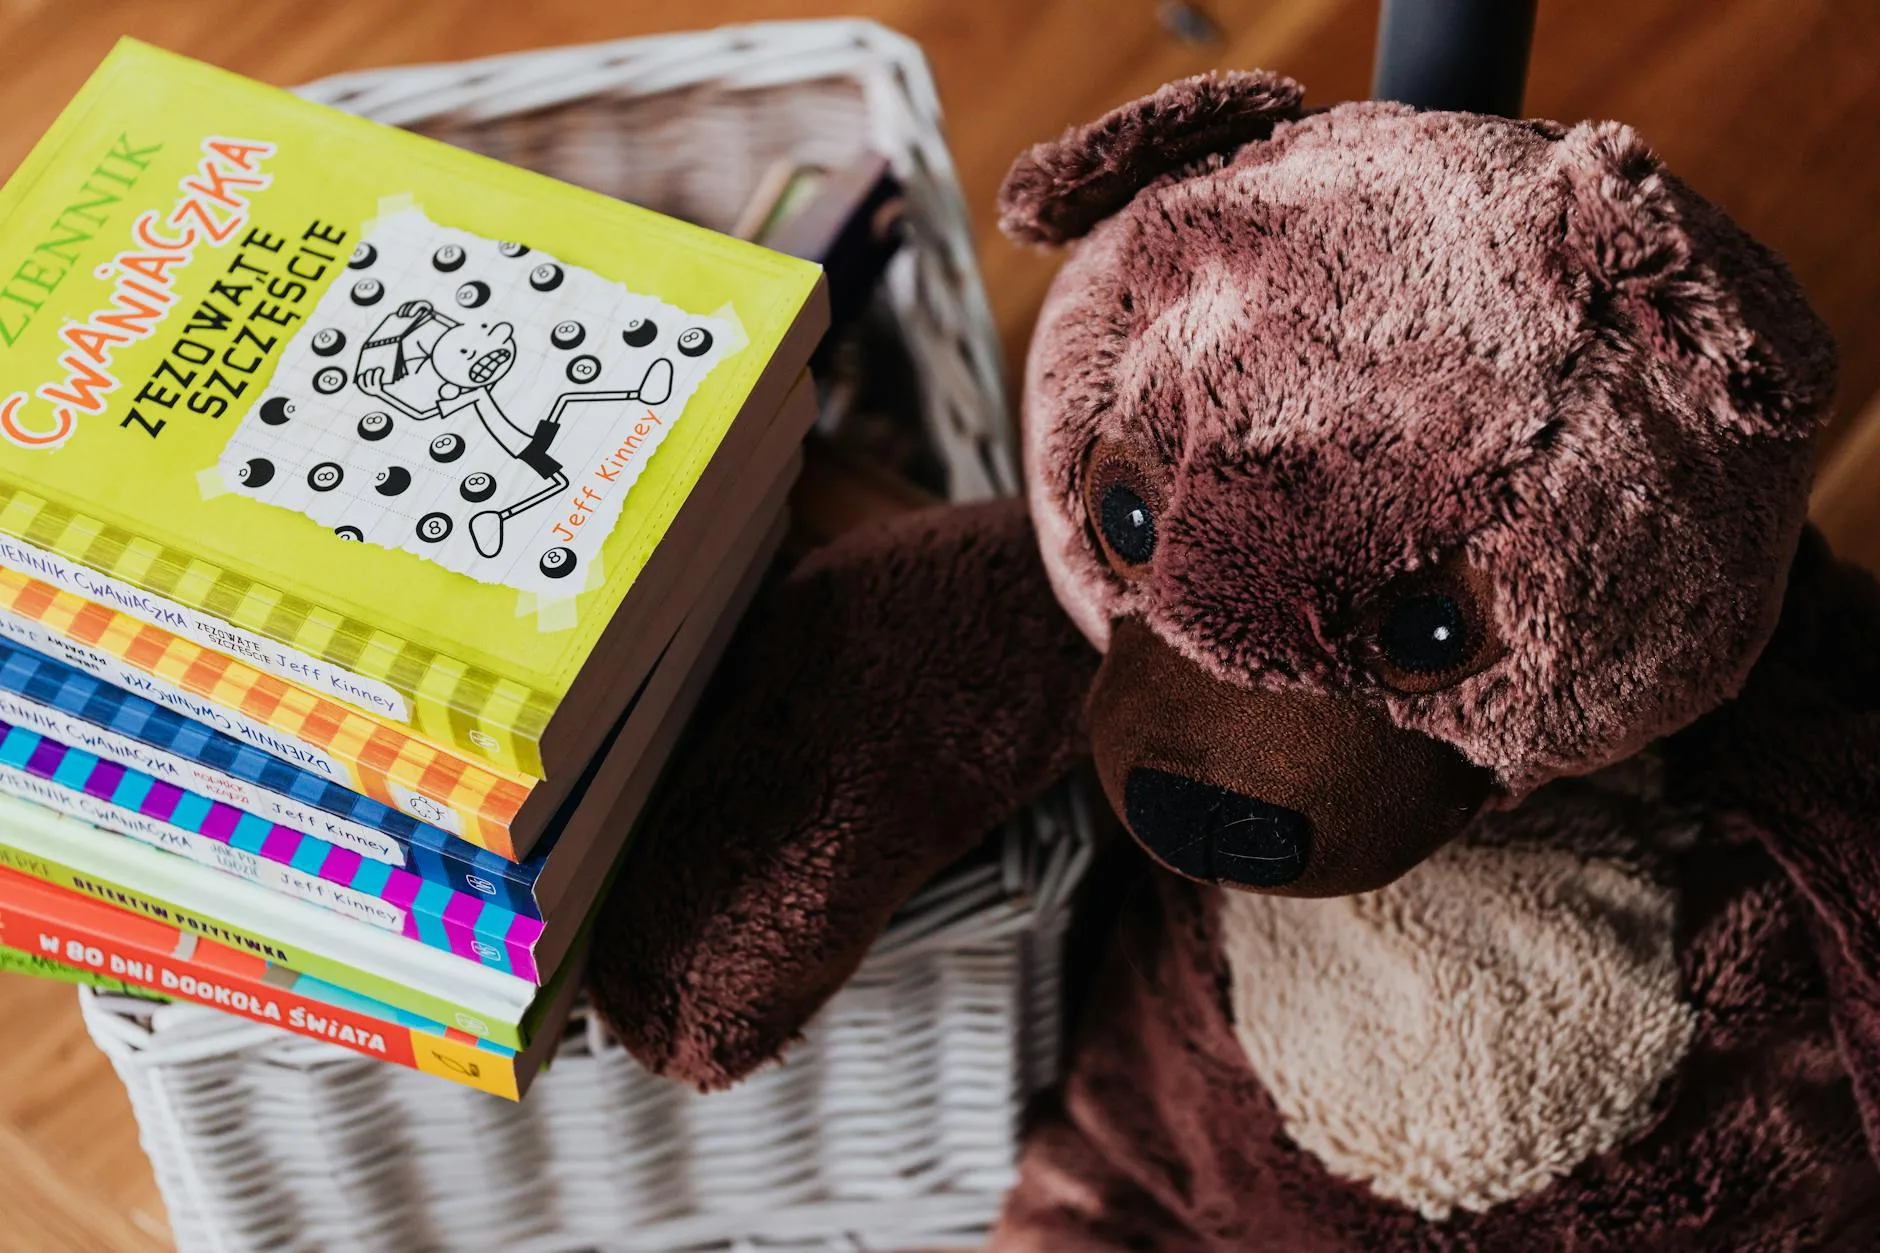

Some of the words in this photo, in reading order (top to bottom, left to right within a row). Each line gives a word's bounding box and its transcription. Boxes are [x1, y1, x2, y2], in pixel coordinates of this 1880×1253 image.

[119, 227, 285, 440] ZEZOWATE
[186, 219, 347, 419] SZCZĘŚCIE
[552, 485, 603, 543] Jeff
[594, 408, 664, 483] Kinney
[276, 654, 320, 681] Jeff
[330, 674, 396, 712] Kinney
[236, 721, 332, 775] DZIENNIK
[272, 802, 315, 826] Jeff
[325, 822, 390, 856] Kinney
[72, 876, 170, 920] DETEKTYW
[174, 911, 289, 962] POZYTYWKA
[280, 873, 324, 896] Jeff
[333, 891, 397, 924] Kinney
[39, 932, 60, 955] W
[65, 939, 105, 968] 80
[161, 968, 281, 1022] DOOKOŁA
